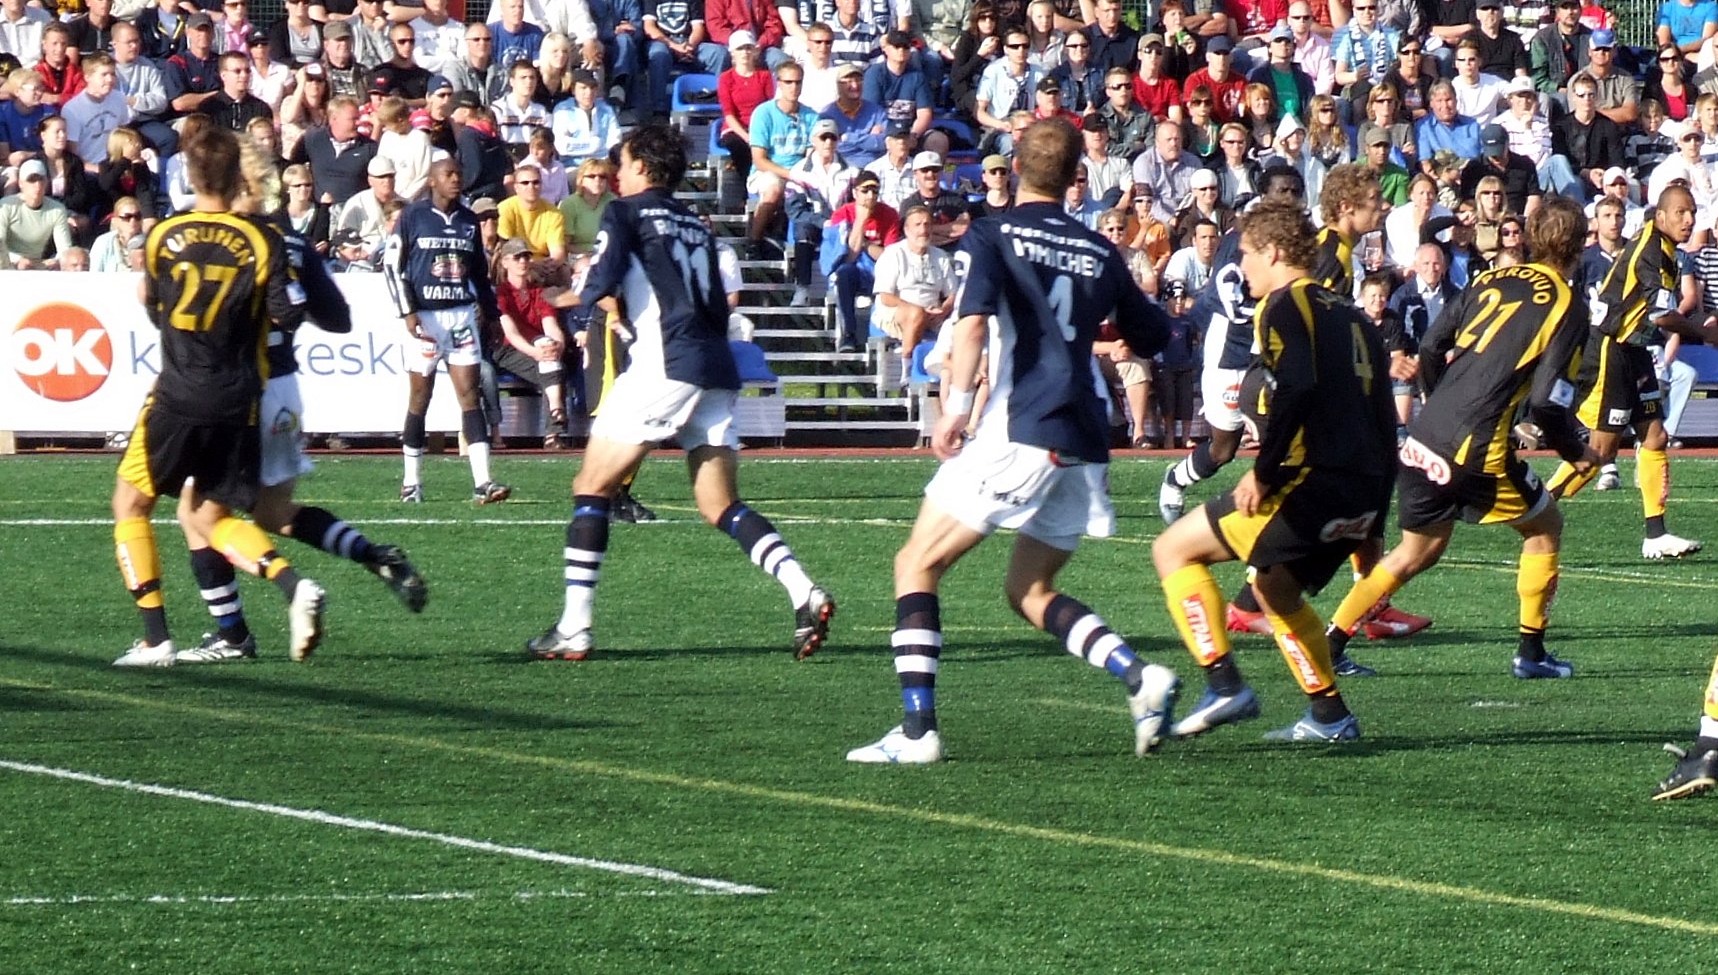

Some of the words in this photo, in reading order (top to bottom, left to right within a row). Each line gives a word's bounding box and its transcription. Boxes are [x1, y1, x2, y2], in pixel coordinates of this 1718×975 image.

[159, 227, 255, 267] TURUNEN
[169, 260, 240, 332] 27
[1480, 266, 1552, 305] PEROVUO
[1455, 287, 1523, 354] 21
[10, 327, 110, 376] OK
[1350, 321, 1375, 396] 4
